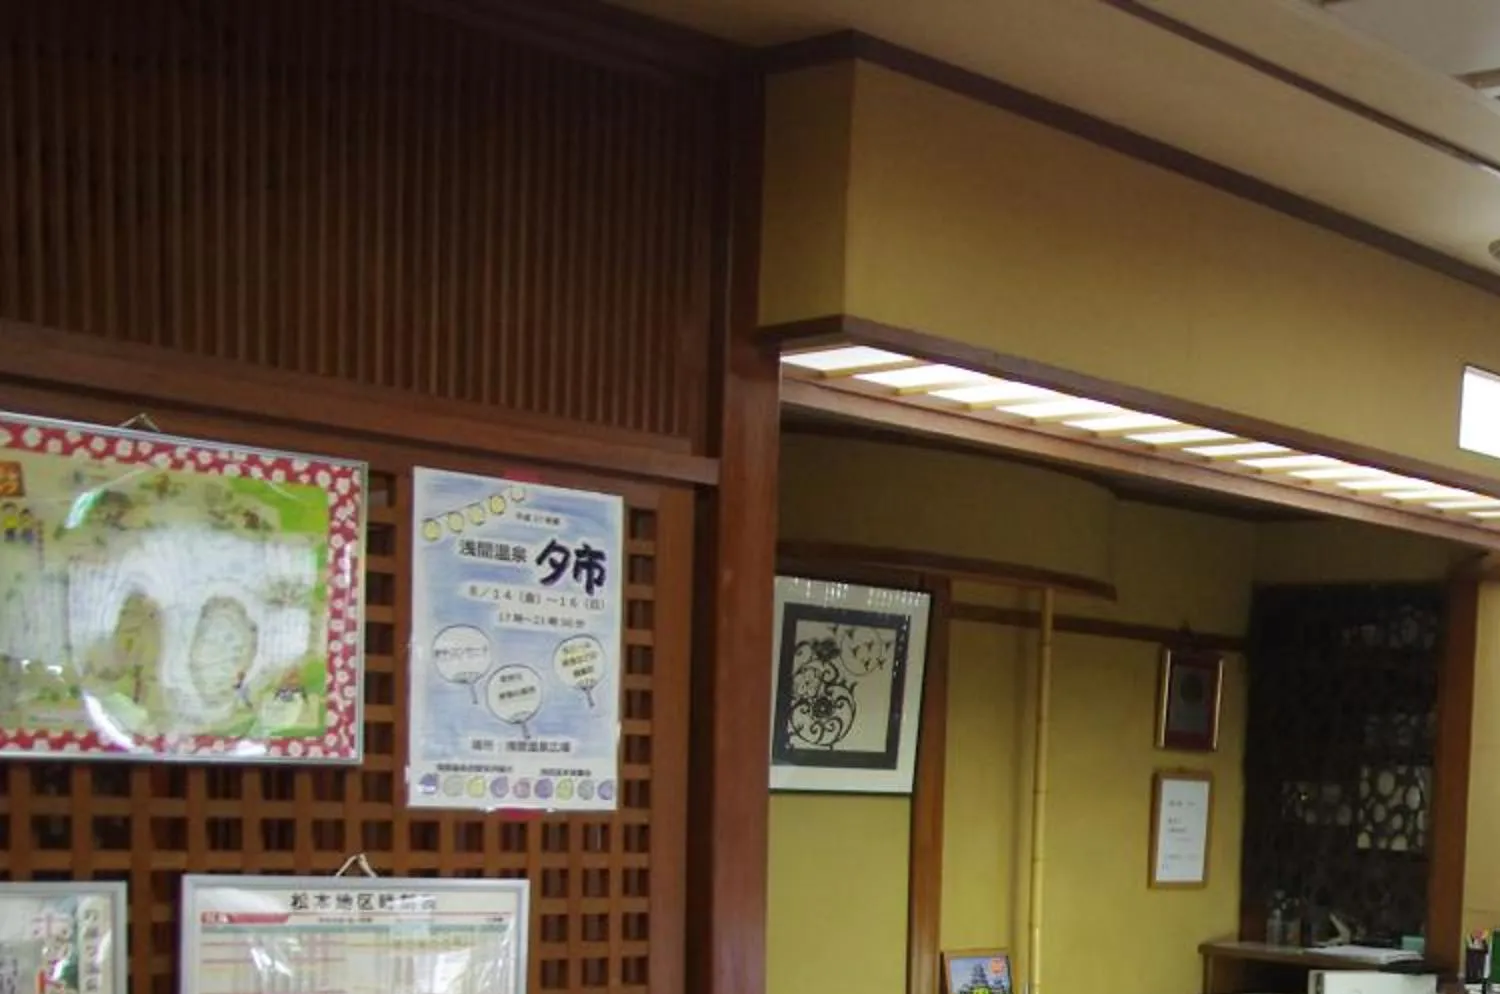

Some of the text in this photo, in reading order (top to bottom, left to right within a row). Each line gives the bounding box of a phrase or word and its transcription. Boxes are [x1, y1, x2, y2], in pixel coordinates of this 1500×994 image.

[460, 539, 606, 596] 浅間温泉 夕市
